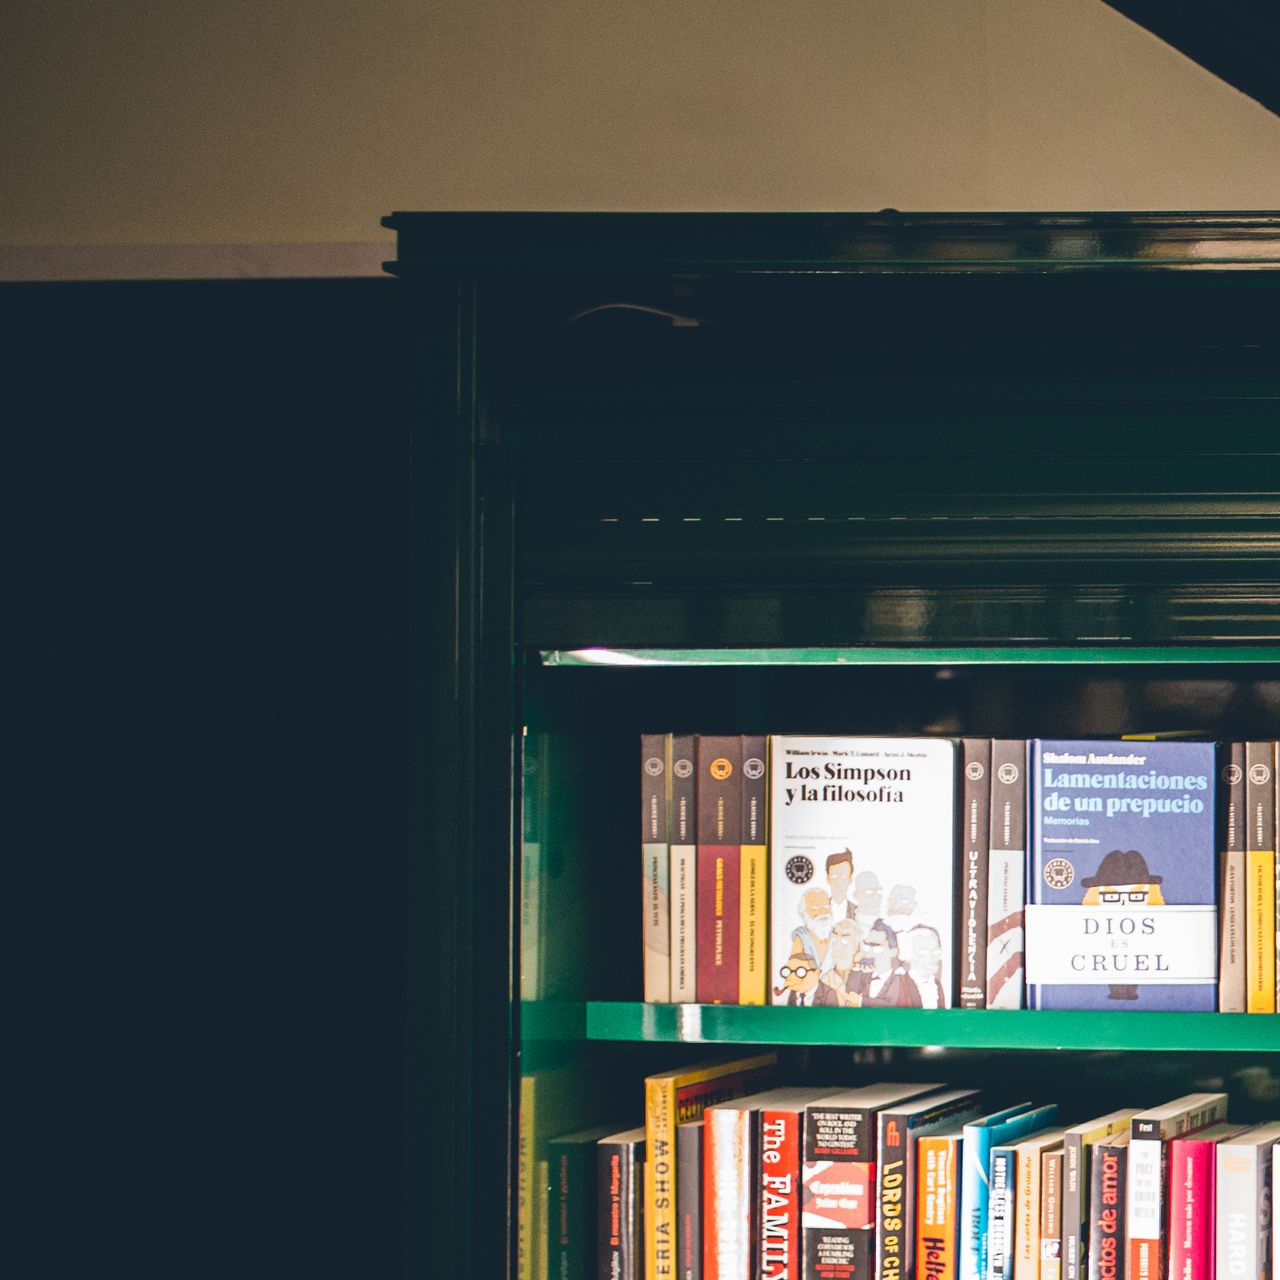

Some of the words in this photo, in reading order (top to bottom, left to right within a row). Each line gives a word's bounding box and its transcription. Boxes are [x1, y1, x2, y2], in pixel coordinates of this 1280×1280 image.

[785, 762, 820, 779] Los
[825, 762, 911, 784] Simpson
[1044, 768, 1208, 791] Lamentaciones
[786, 787, 794, 805] y
[801, 785, 818, 802] la
[822, 785, 904, 802] filosofía
[1044, 794, 1071, 812] de
[1074, 797, 1104, 812] un
[1106, 795, 1204, 818] prepucio
[1044, 817, 1089, 826] Memorias
[1084, 918, 1156, 935] DIOS
[1111, 939, 1129, 948] ES
[1071, 954, 1169, 972] CRUEL
[763, 1119, 785, 1163] The
[655, 1140, 670, 1209] SHOW
[1103, 1153, 1118, 1204] amor
[882, 1160, 903, 1231] LORDS
[1099, 1209, 1117, 1233] de
[884, 1235, 899, 1253] OF
[1229, 1213, 1247, 1273] HARD
